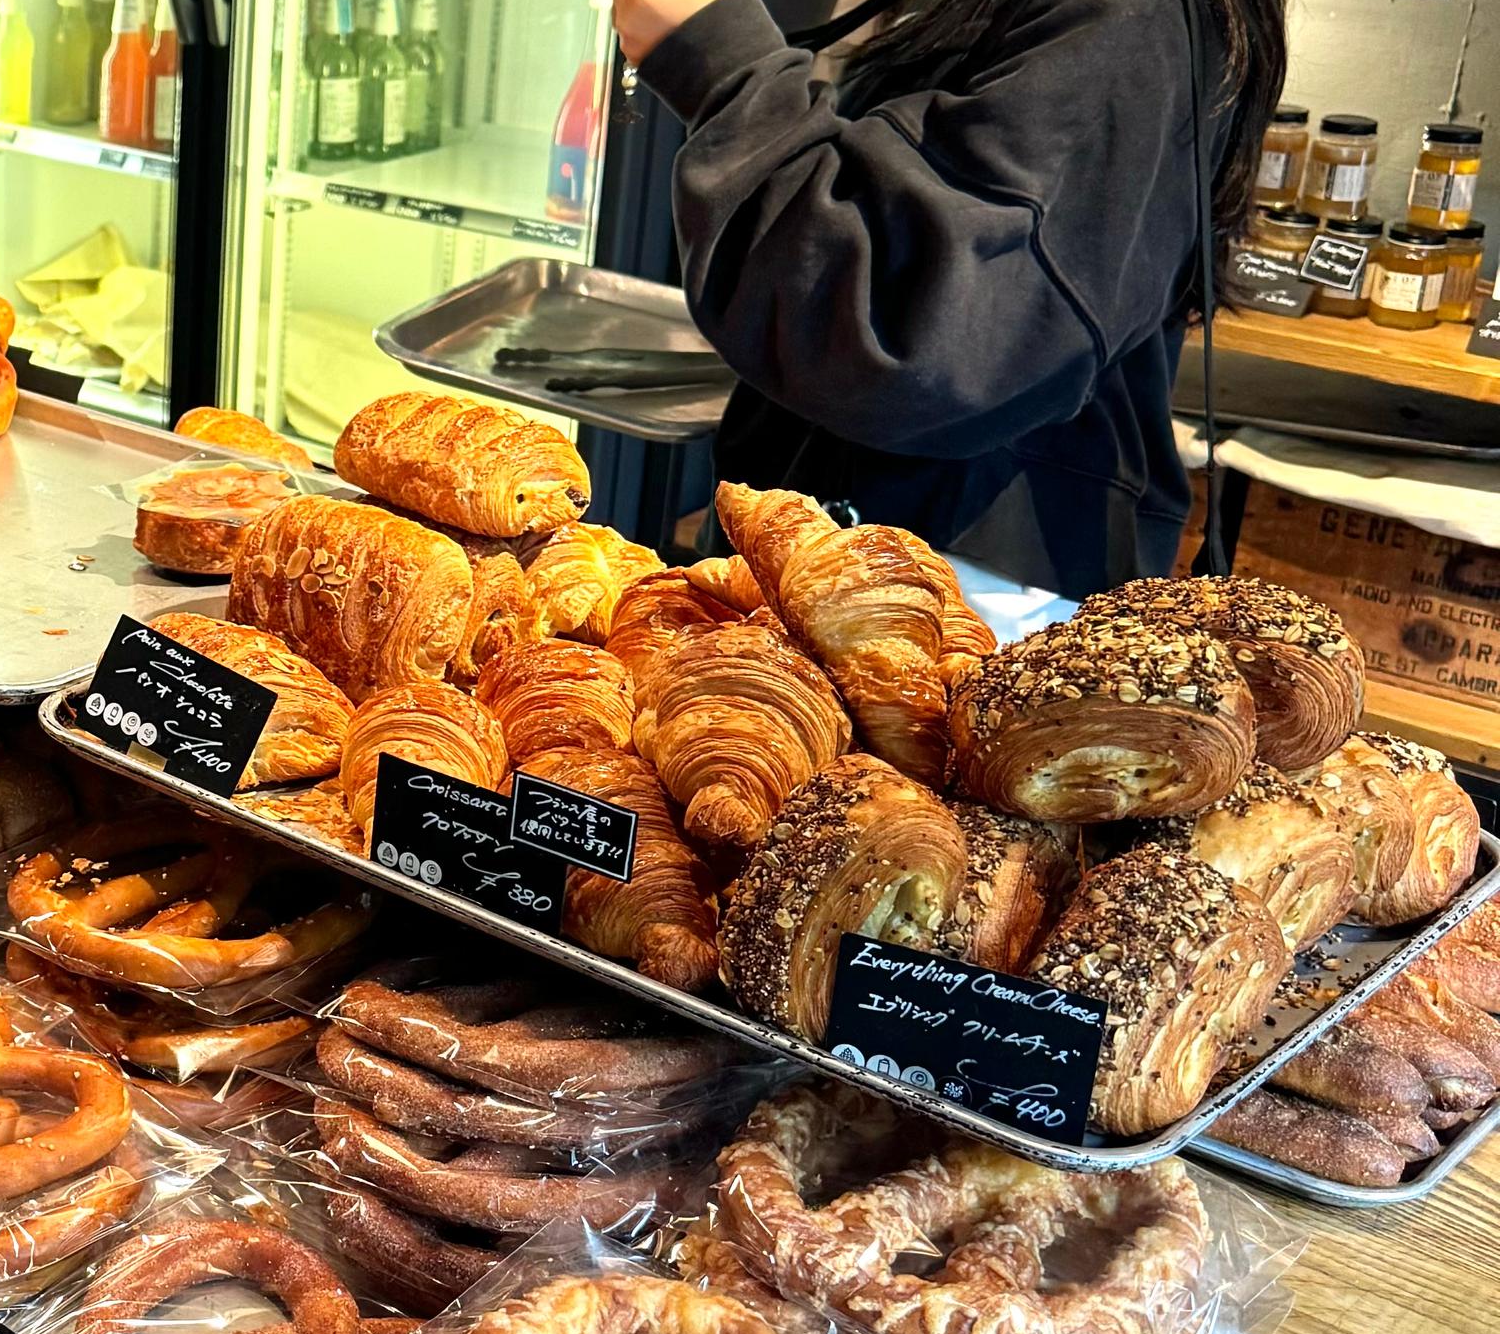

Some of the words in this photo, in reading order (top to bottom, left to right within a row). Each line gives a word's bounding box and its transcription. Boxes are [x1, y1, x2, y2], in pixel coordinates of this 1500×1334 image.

[150, 660, 234, 711] Chocolate
[1436, 668, 1500, 695] CAMBR
[408, 775, 509, 817] Croissant
[850, 942, 969, 995] Everything
